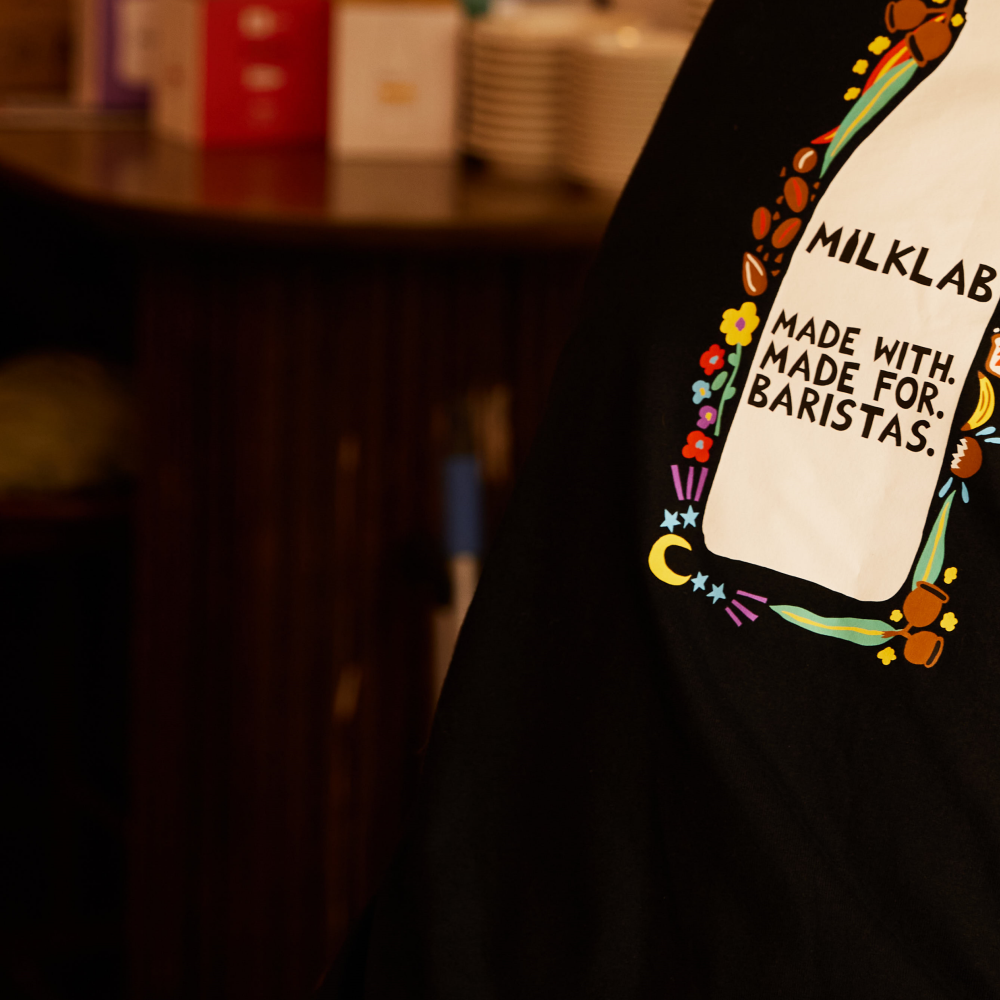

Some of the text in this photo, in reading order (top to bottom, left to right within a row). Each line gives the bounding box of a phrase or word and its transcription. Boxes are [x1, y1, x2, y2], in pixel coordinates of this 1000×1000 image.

[805, 221, 997, 303] MILKLAB
[759, 340, 944, 420] MADE FOR.
[770, 308, 955, 385] MADE WITH.
[747, 373, 935, 457] BARISTAS.
